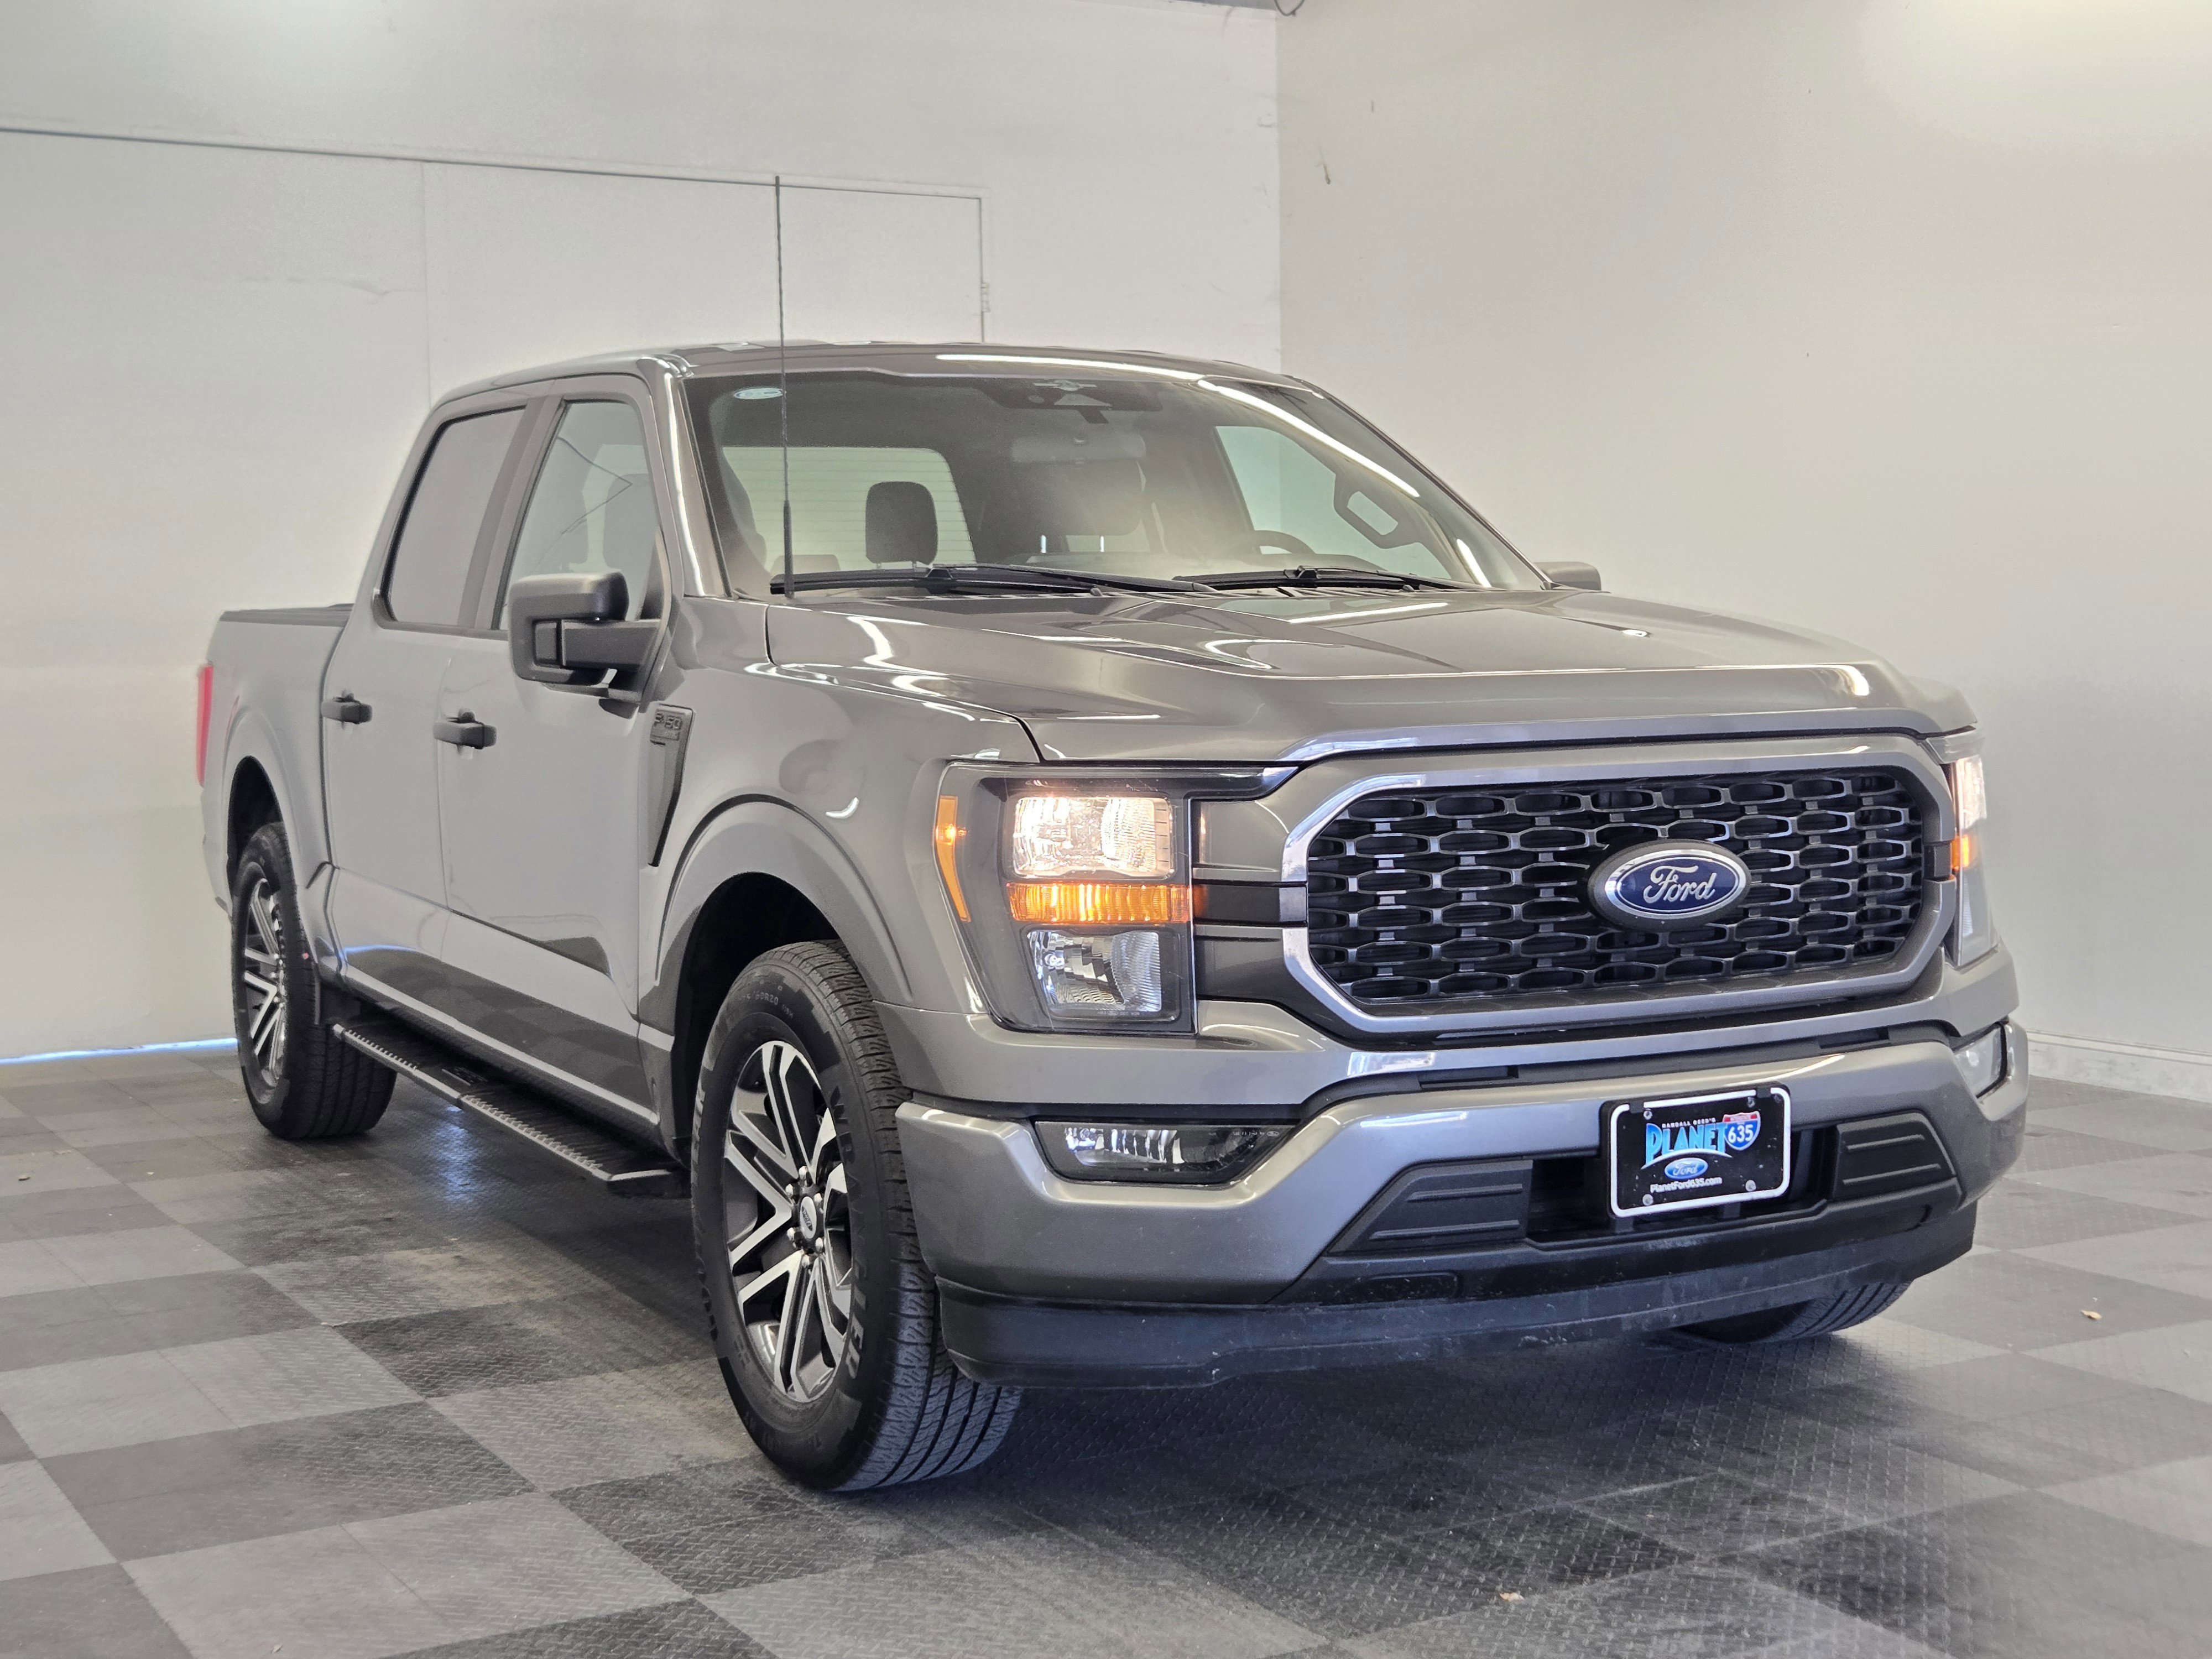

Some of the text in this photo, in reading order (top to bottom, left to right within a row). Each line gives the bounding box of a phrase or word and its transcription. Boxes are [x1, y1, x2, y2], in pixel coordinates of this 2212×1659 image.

[1643, 865, 1717, 904] Ford
[1645, 1121, 1728, 1165] PLANET
[1728, 1124, 1754, 1144] 635
[1672, 1162, 1698, 1176] Ford
[1650, 1177, 1723, 1193] PlanetFord635.com
